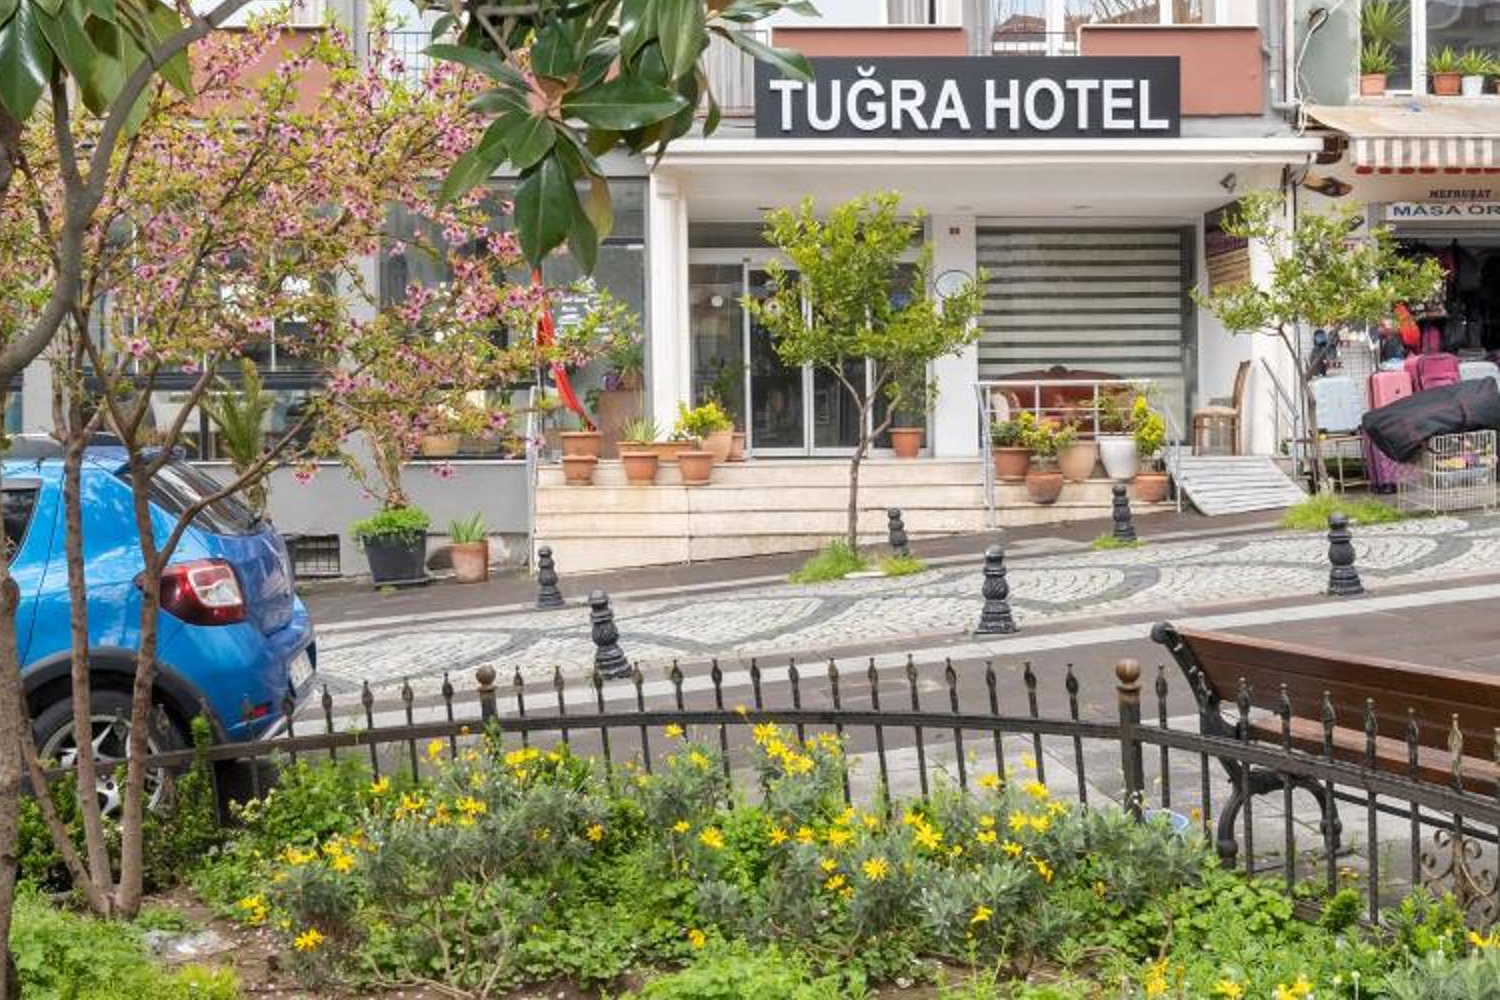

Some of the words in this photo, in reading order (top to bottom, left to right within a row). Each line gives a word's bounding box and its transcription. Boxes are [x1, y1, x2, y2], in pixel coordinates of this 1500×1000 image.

[769, 66, 971, 130] TUĞRA
[985, 78, 1169, 130] HOTEL
[1393, 205, 1461, 216] MASA
